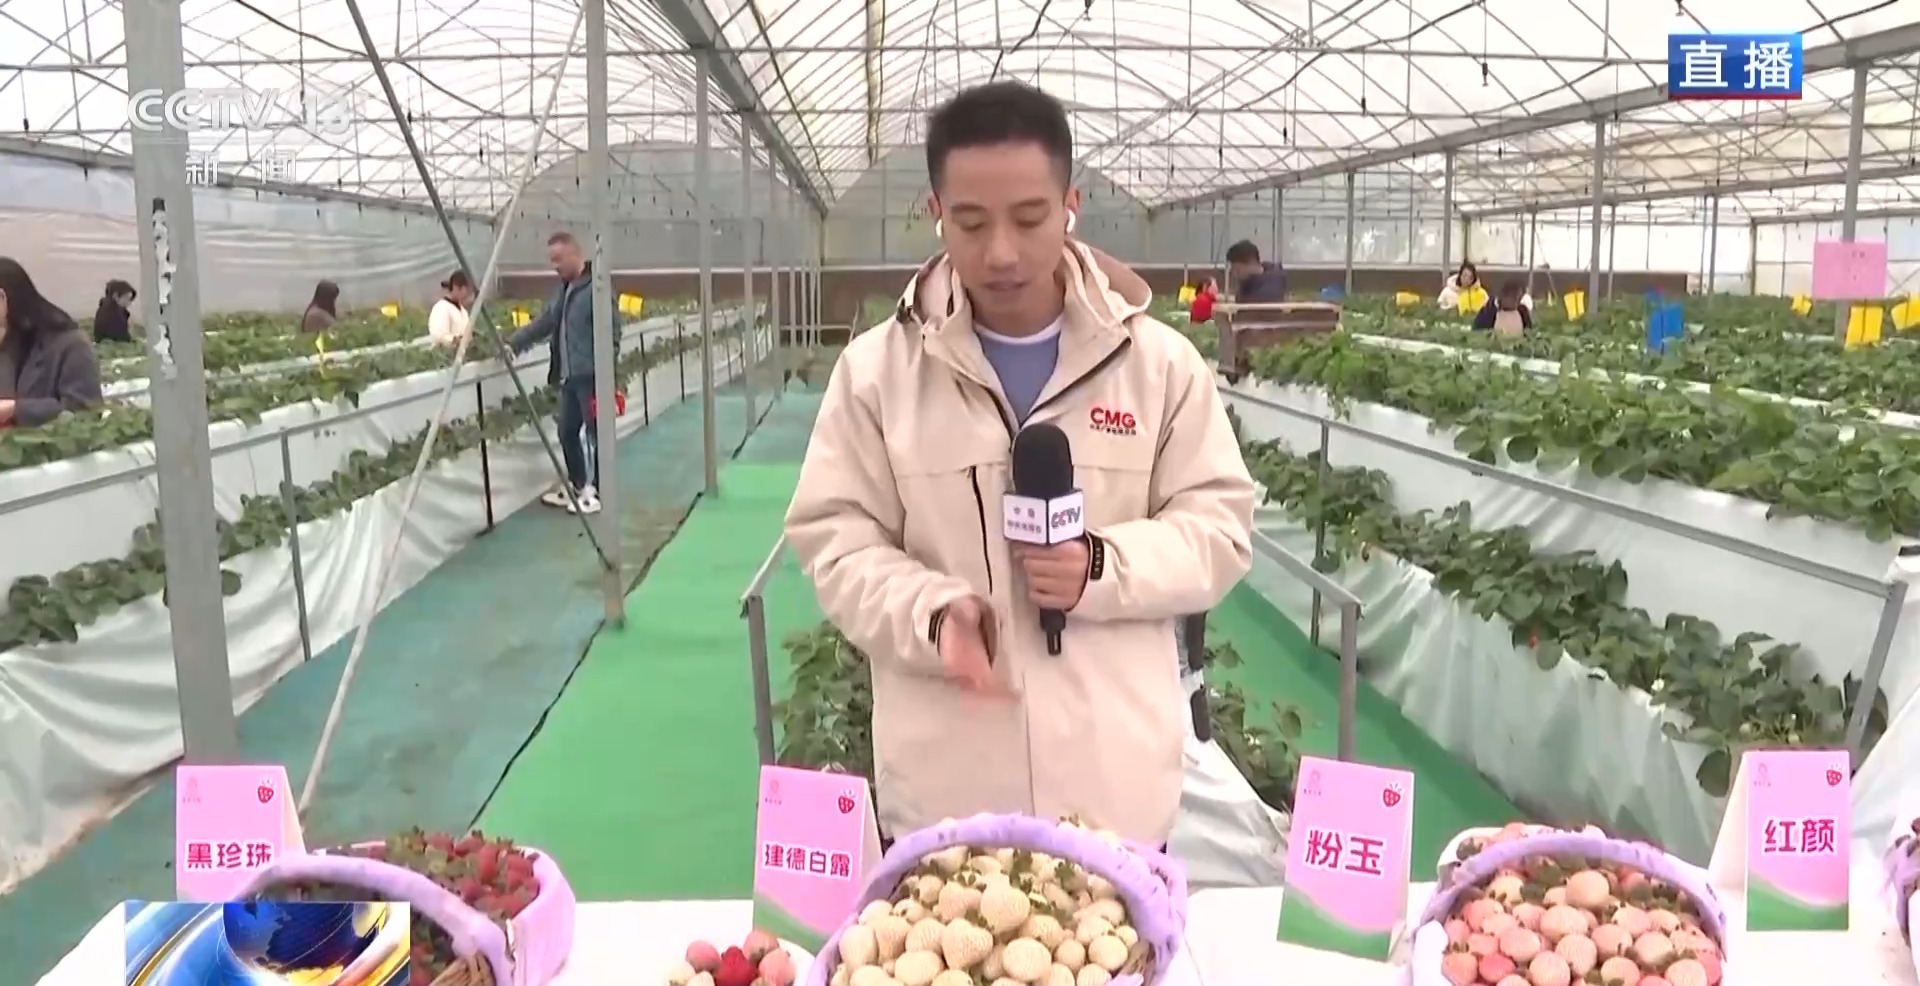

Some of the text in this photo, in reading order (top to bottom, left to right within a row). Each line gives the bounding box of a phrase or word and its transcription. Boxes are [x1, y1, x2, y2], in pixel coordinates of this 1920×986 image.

[1090, 406, 1136, 429] CMG
[1051, 505, 1081, 529] CCTV
[1764, 819, 1835, 853] 红颜
[187, 842, 272, 869] 黑珍珠
[764, 843, 850, 877] 建德白露
[1305, 829, 1384, 876] 粉玉
